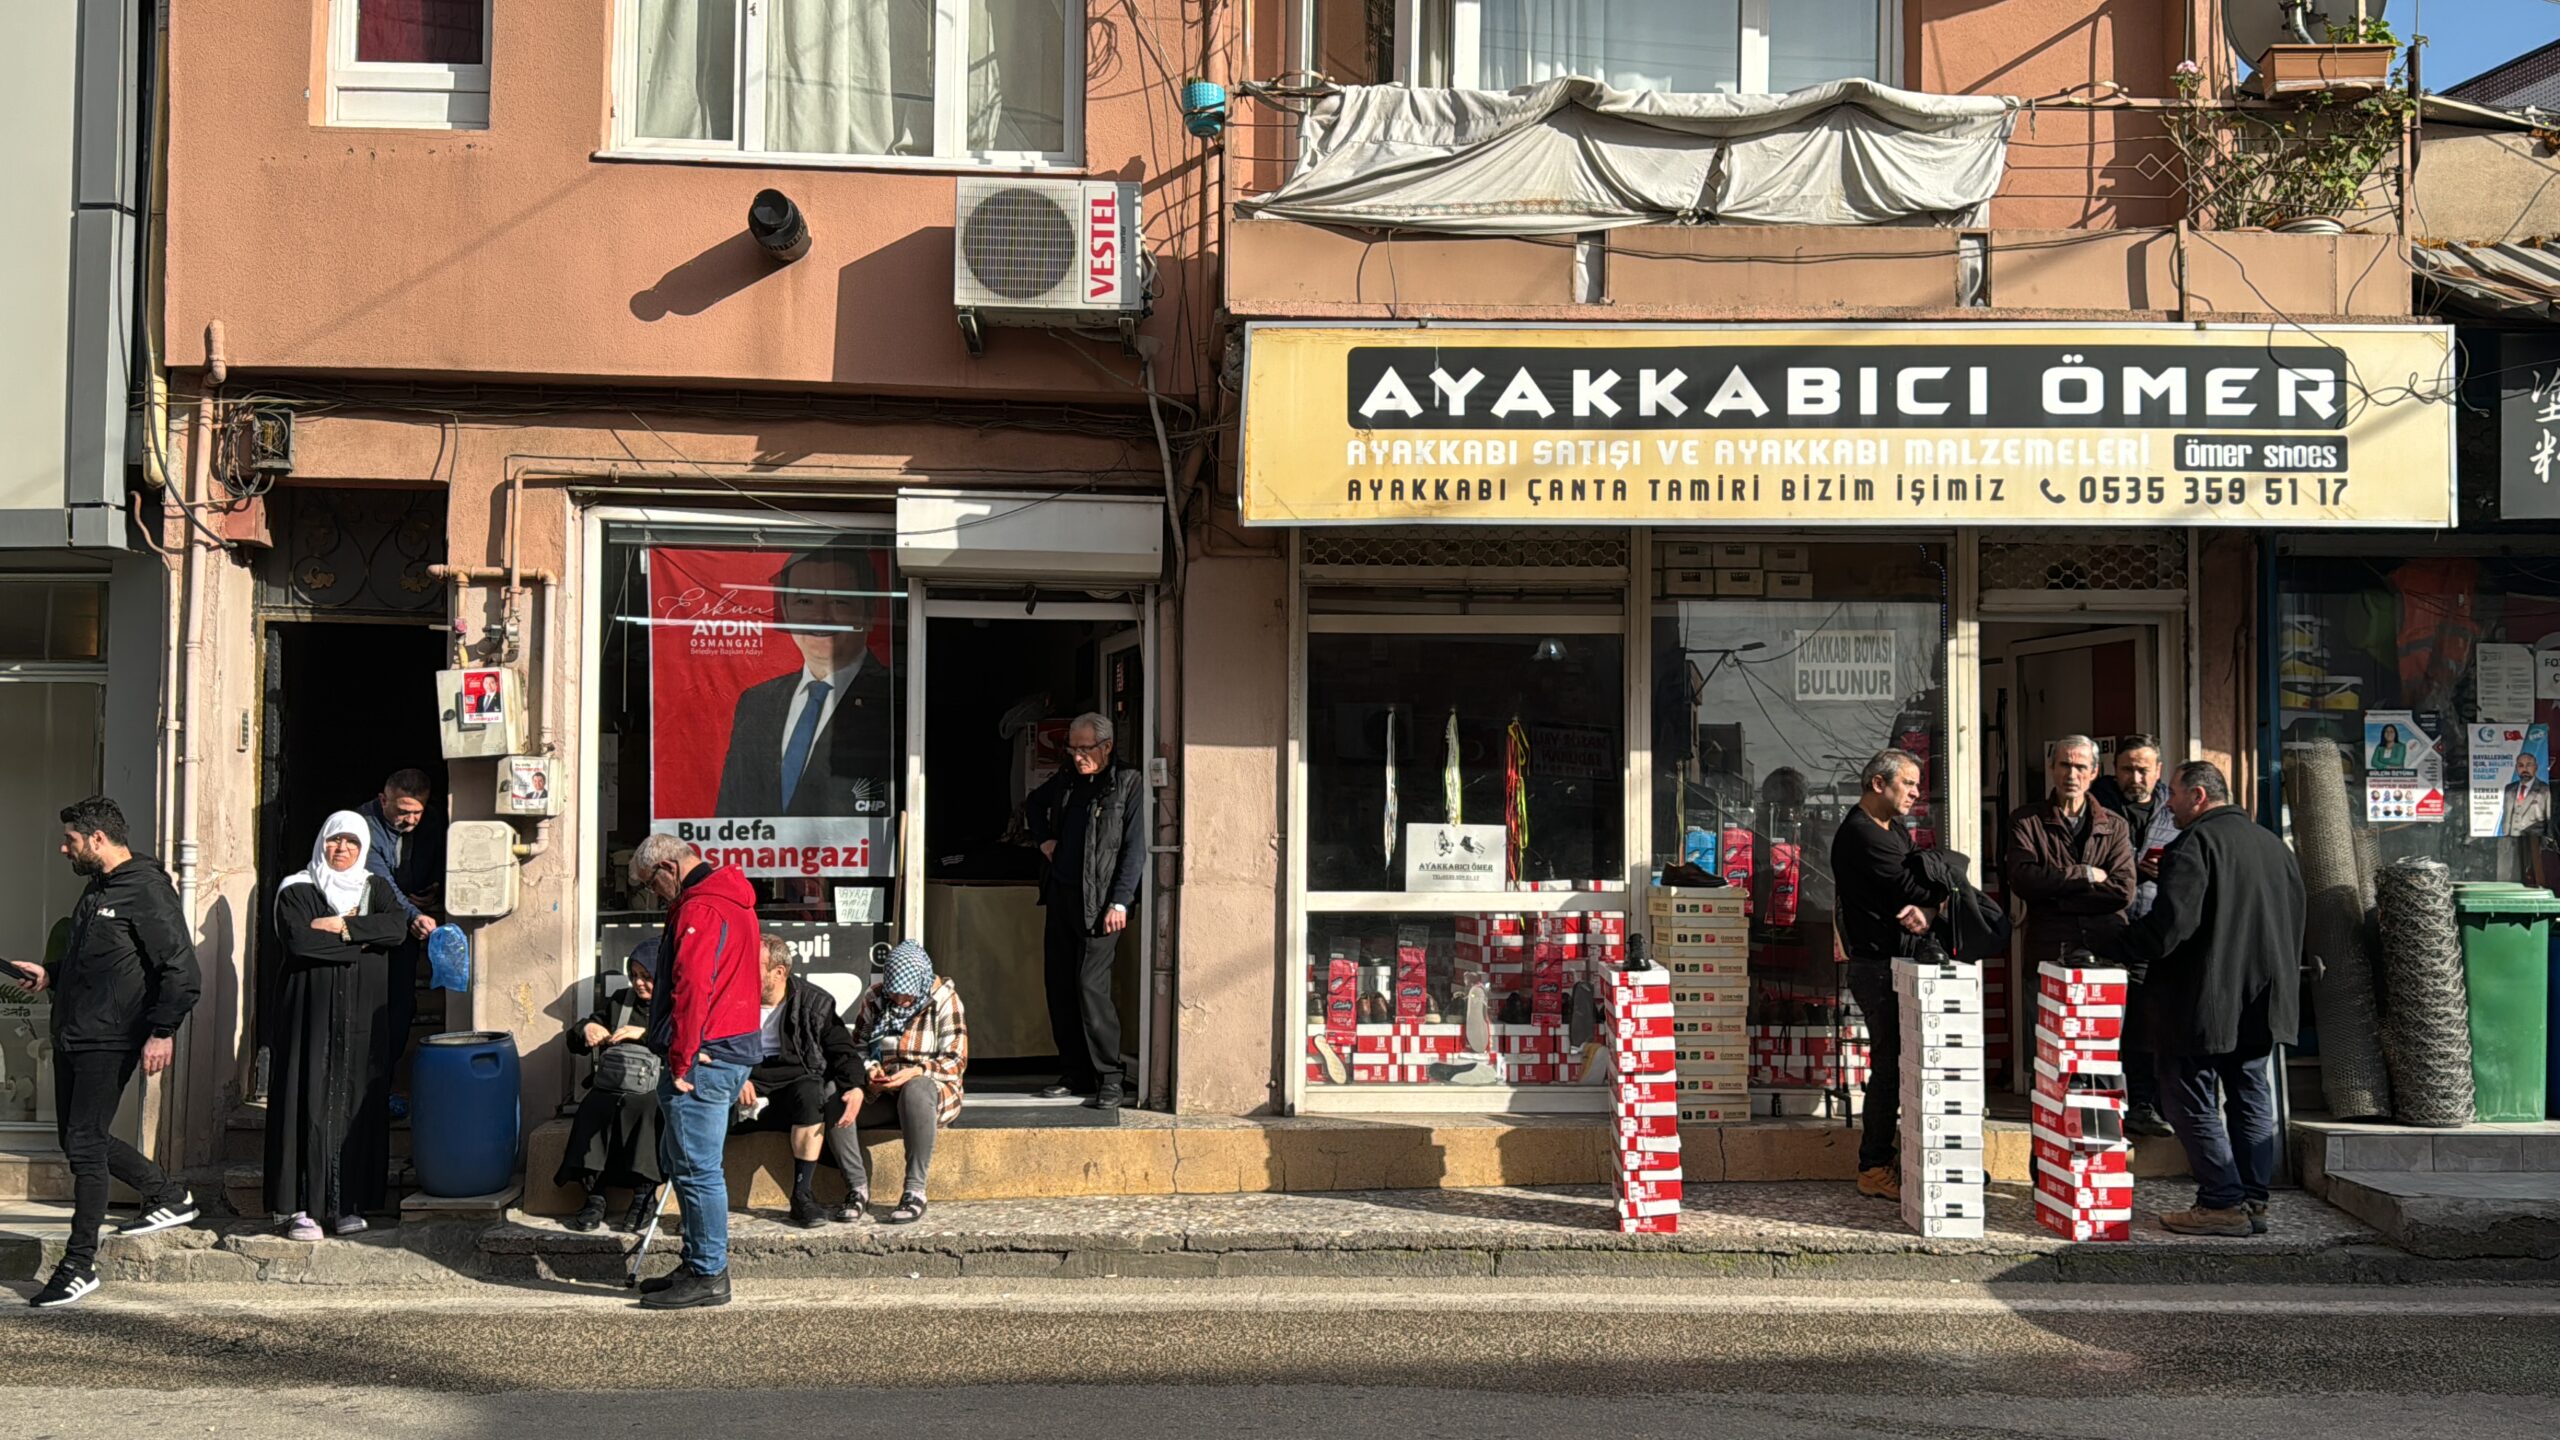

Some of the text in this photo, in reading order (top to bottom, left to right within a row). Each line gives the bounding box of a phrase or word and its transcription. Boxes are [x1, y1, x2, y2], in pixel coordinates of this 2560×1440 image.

[1090, 191, 1116, 298] VESTEL
[1357, 354, 2340, 420] AYAKKABICI ÖMER
[1347, 432, 2151, 471] AYAKKABI SATIŞI VE AYAKKABI MALZEMELERİ
[2263, 441, 2338, 469] shoes
[1347, 478, 1508, 501] AYAKKABI
[1527, 478, 1628, 506] ÇANTA
[2079, 476, 2165, 505] 0535
[2184, 476, 2247, 505] 359
[2265, 476, 2299, 505] 51
[2317, 477, 2349, 505] 17
[692, 620, 764, 637] AYDIN
[690, 637, 763, 649] OSMANGAZİ
[1798, 636, 1851, 664] AYAKKABI
[1798, 669, 1892, 695] BULUNUR
[855, 800, 886, 812] CHP
[678, 819, 776, 841] Bu defa
[1471, 862, 1493, 872] ÖMER
